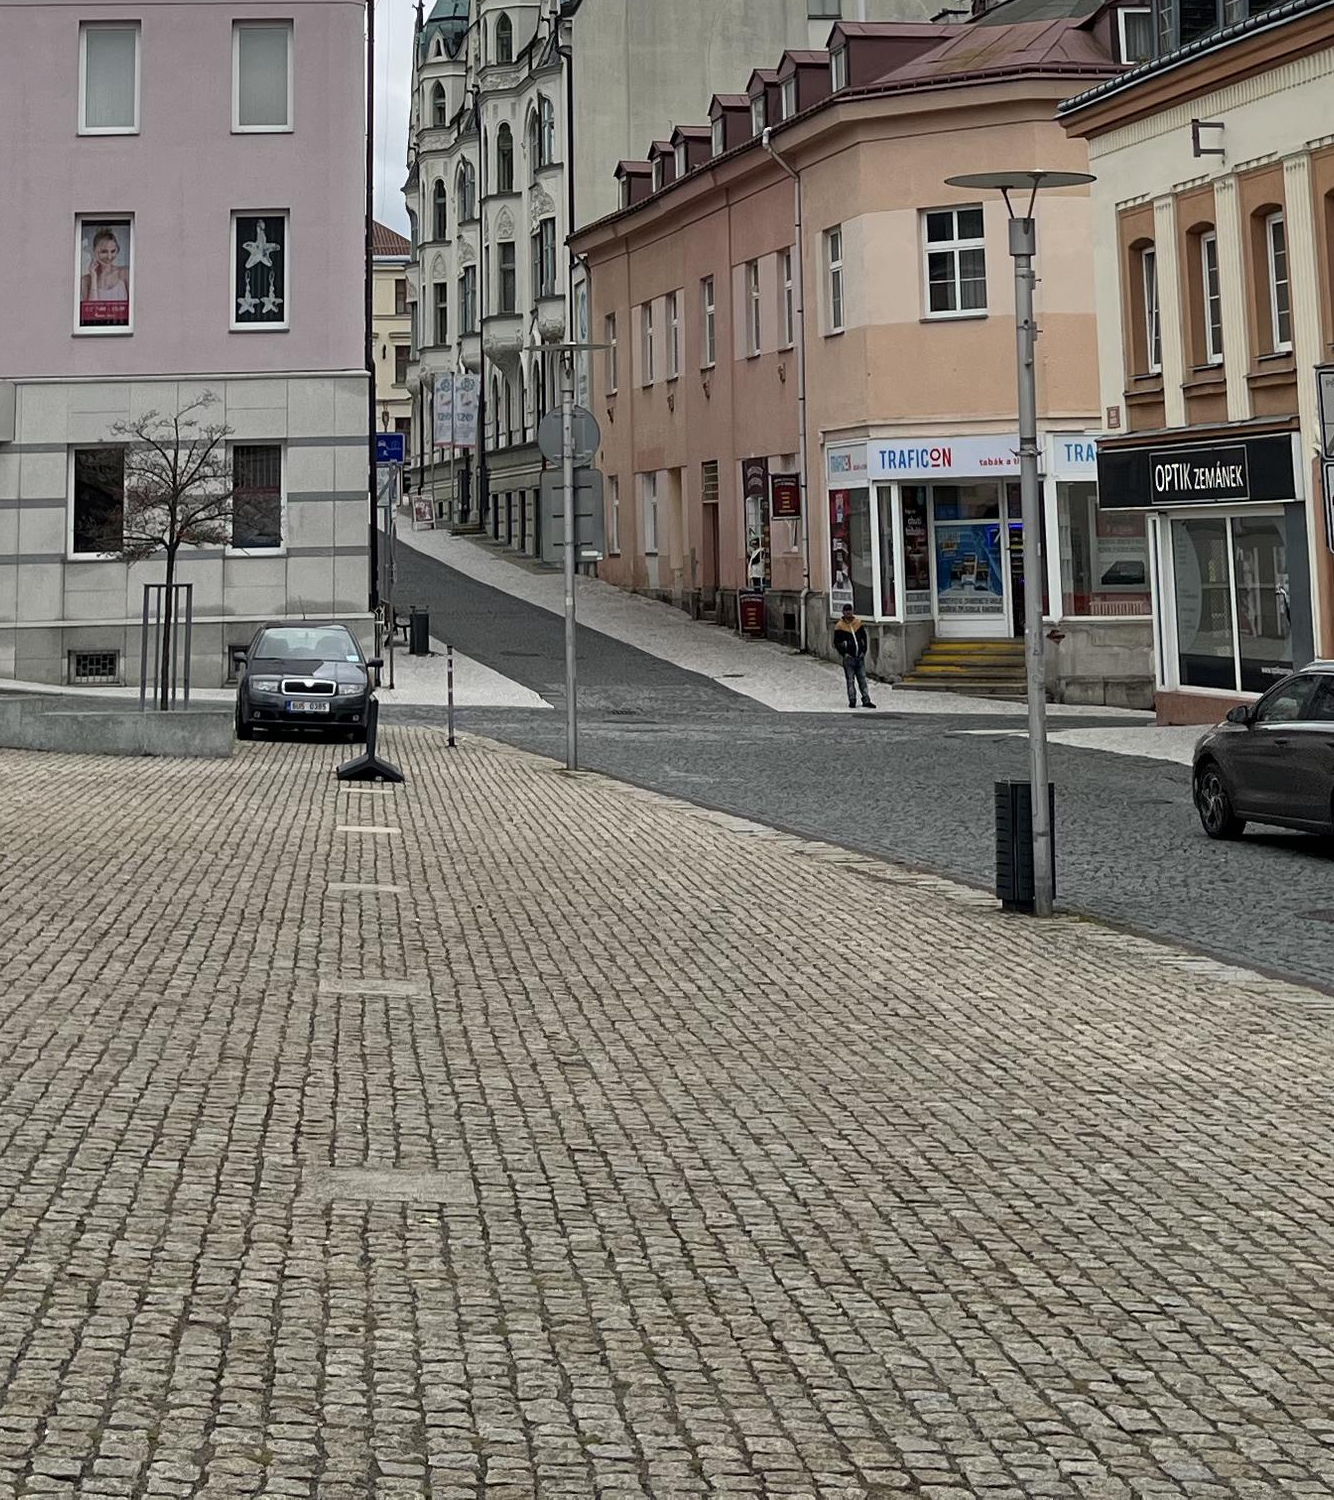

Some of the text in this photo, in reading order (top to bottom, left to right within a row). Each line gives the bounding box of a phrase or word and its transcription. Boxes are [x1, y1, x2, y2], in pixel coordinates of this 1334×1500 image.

[879, 448, 952, 469] TRAFICON
[979, 458, 1004, 466] tabák
[1065, 443, 1095, 462] TRA
[1155, 461, 1244, 492] OPTIK ZEMÁNEK
